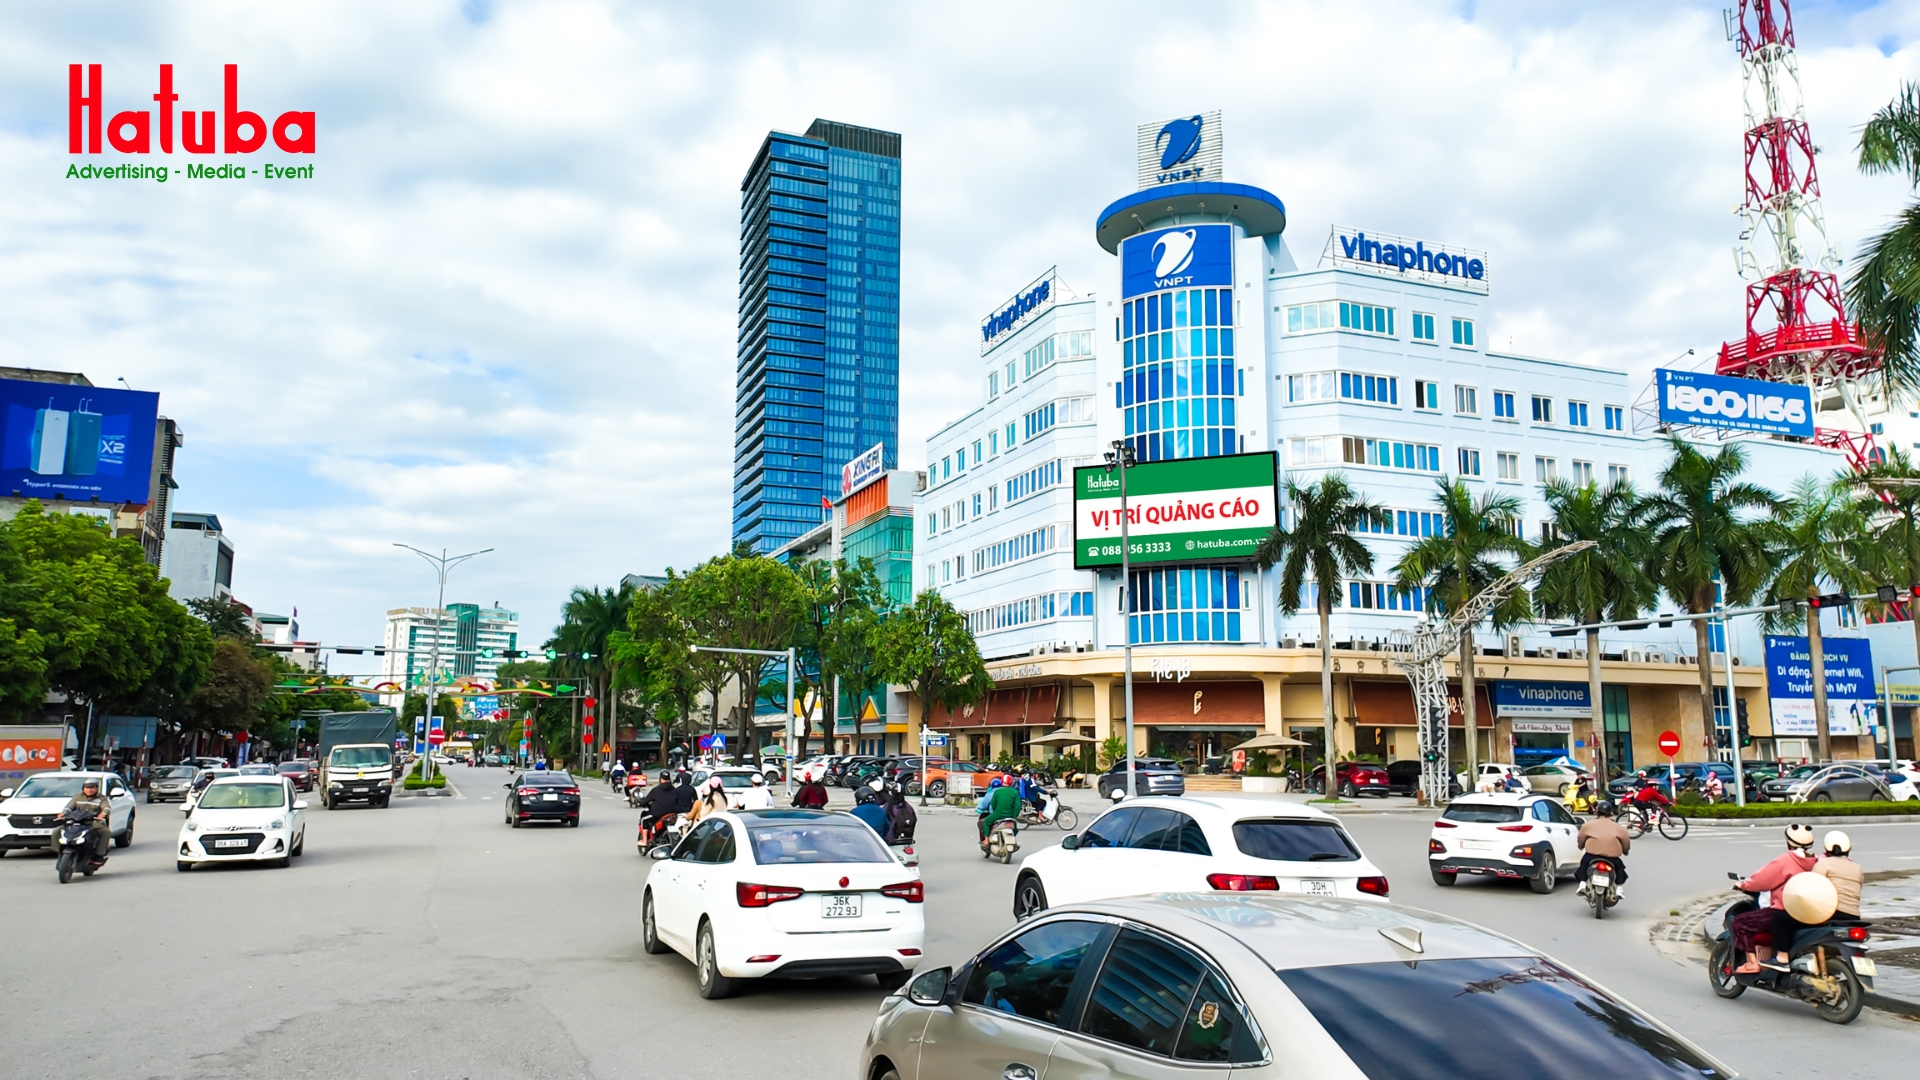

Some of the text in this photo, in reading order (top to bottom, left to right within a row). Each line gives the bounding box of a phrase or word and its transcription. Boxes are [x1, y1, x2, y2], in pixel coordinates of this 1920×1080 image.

[1157, 167, 1204, 183] VNPT
[1340, 232, 1485, 280] vinaphone
[1154, 276, 1194, 288] VNPT
[981, 280, 1050, 342] vinaphone
[1674, 374, 1694, 382] VNPT
[101, 440, 125, 454] X2
[1087, 474, 1119, 488] Hatuba
[1091, 496, 1260, 531] VỊ TRÍ QUẢNG CÁO
[1145, 542, 1171, 552] 3333
[1777, 666, 1786, 675] Di
[1518, 685, 1584, 702] vinaphone
[1311, 881, 1326, 890] 30H
[833, 896, 850, 905] 36K
